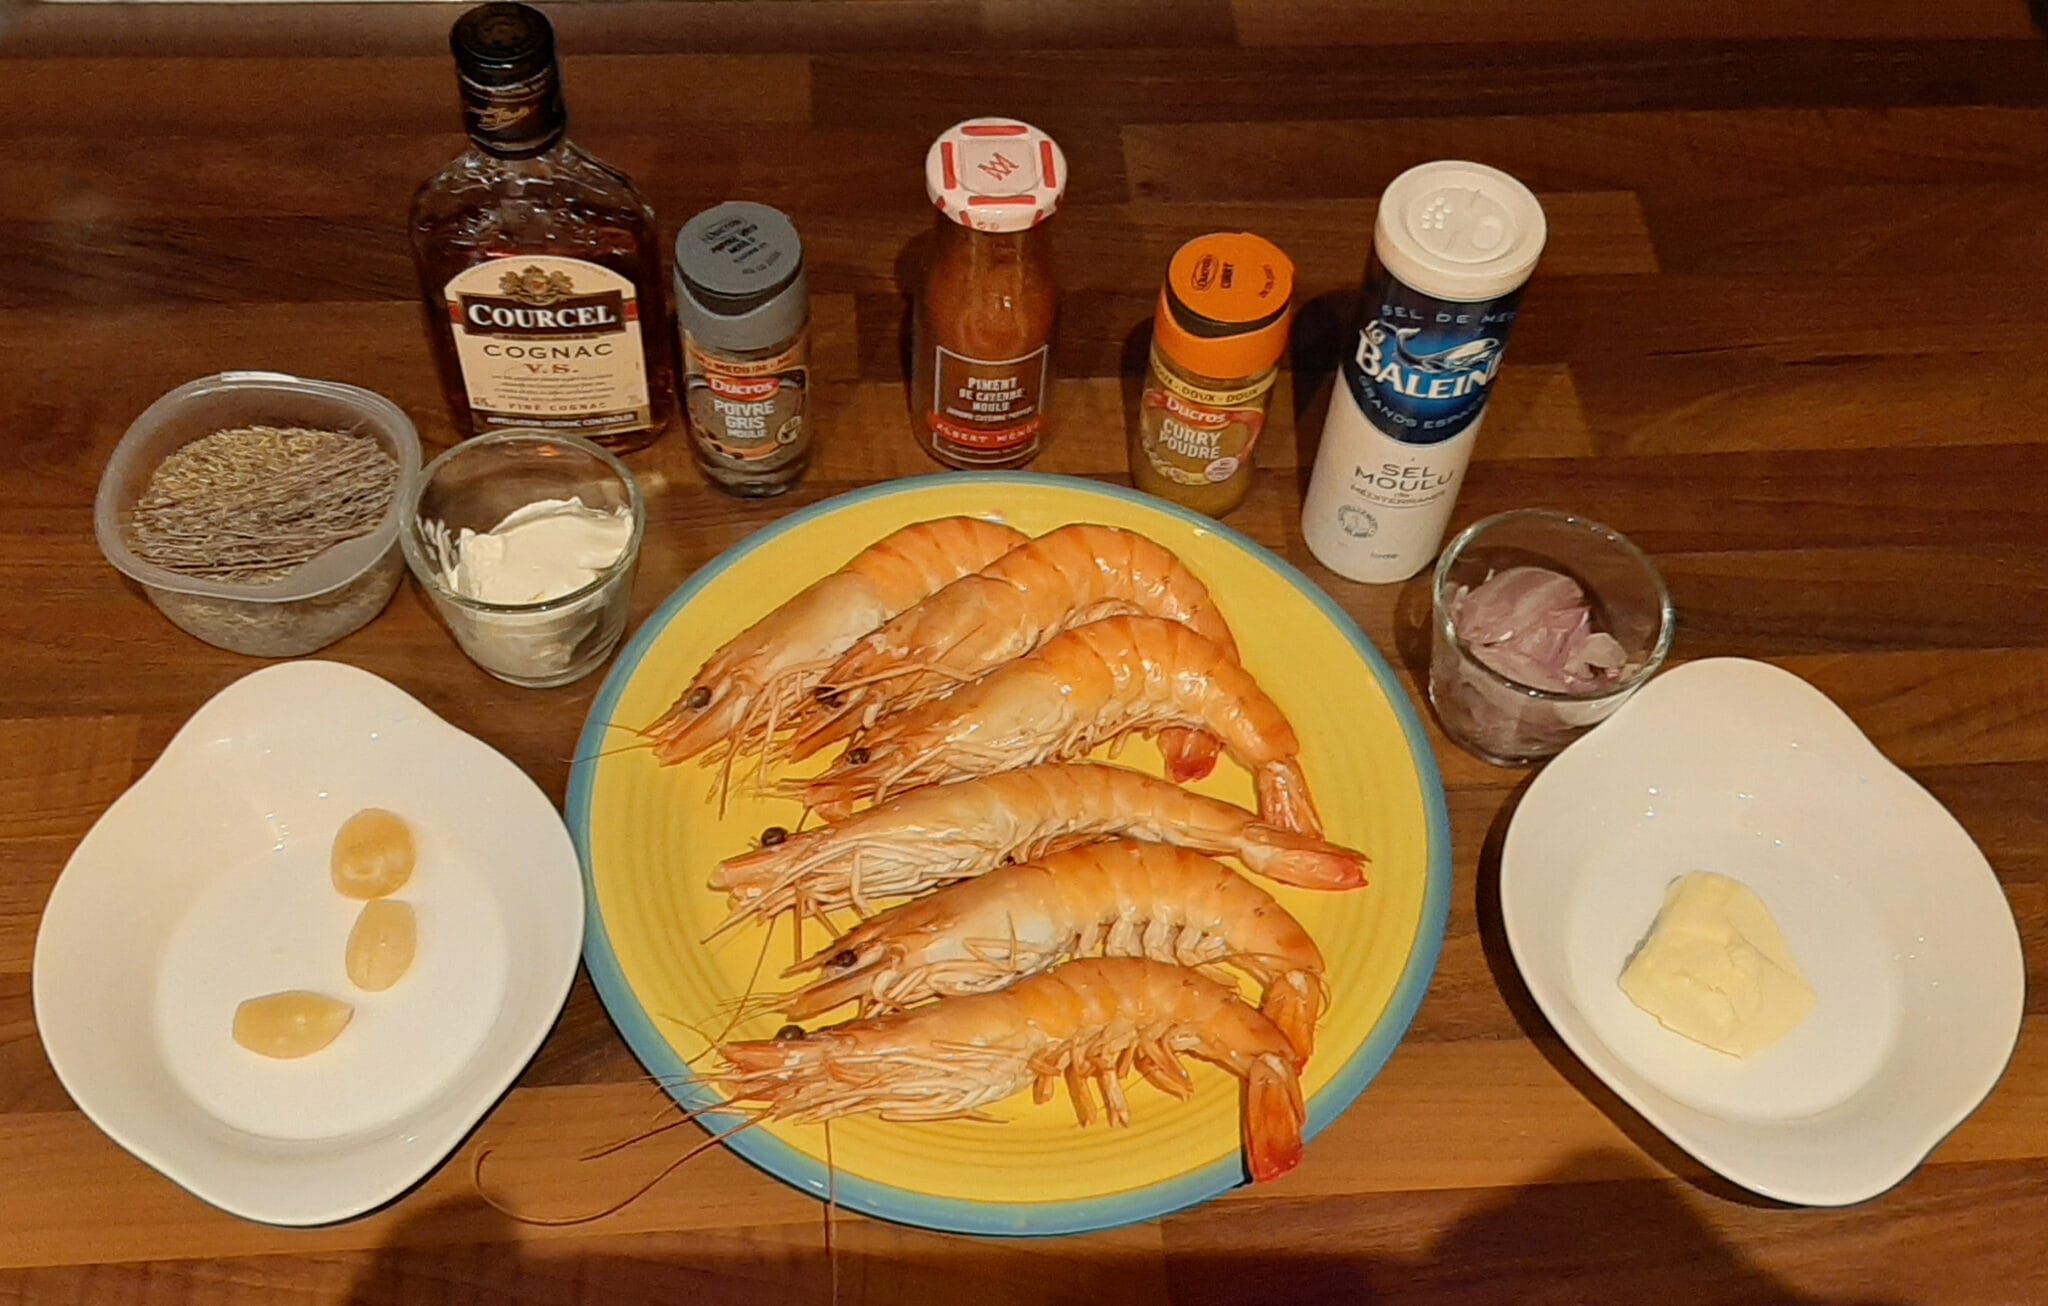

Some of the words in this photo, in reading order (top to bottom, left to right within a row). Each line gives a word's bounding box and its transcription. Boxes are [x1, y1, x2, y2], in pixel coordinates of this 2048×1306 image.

[468, 303, 617, 328] COURCEL
[1382, 304, 1424, 320] SEL
[1435, 313, 1471, 324] DE
[1480, 312, 1517, 323] ME
[483, 343, 614, 360] COGNAC
[525, 363, 580, 375] V.S.
[1356, 329, 1503, 399] BALEIN
[710, 378, 774, 395] Ducros
[968, 377, 1017, 391] PIMENT
[508, 402, 541, 411] FINE
[549, 401, 608, 411] COGNAC
[714, 400, 775, 416] POIVRE
[1166, 396, 1227, 423] Ducros
[725, 416, 766, 430] GRIS
[1163, 419, 1221, 446] CURRY
[1159, 430, 1220, 459] POUDRE
[1354, 464, 1456, 492] MOULU
[1381, 463, 1437, 479] SEL
